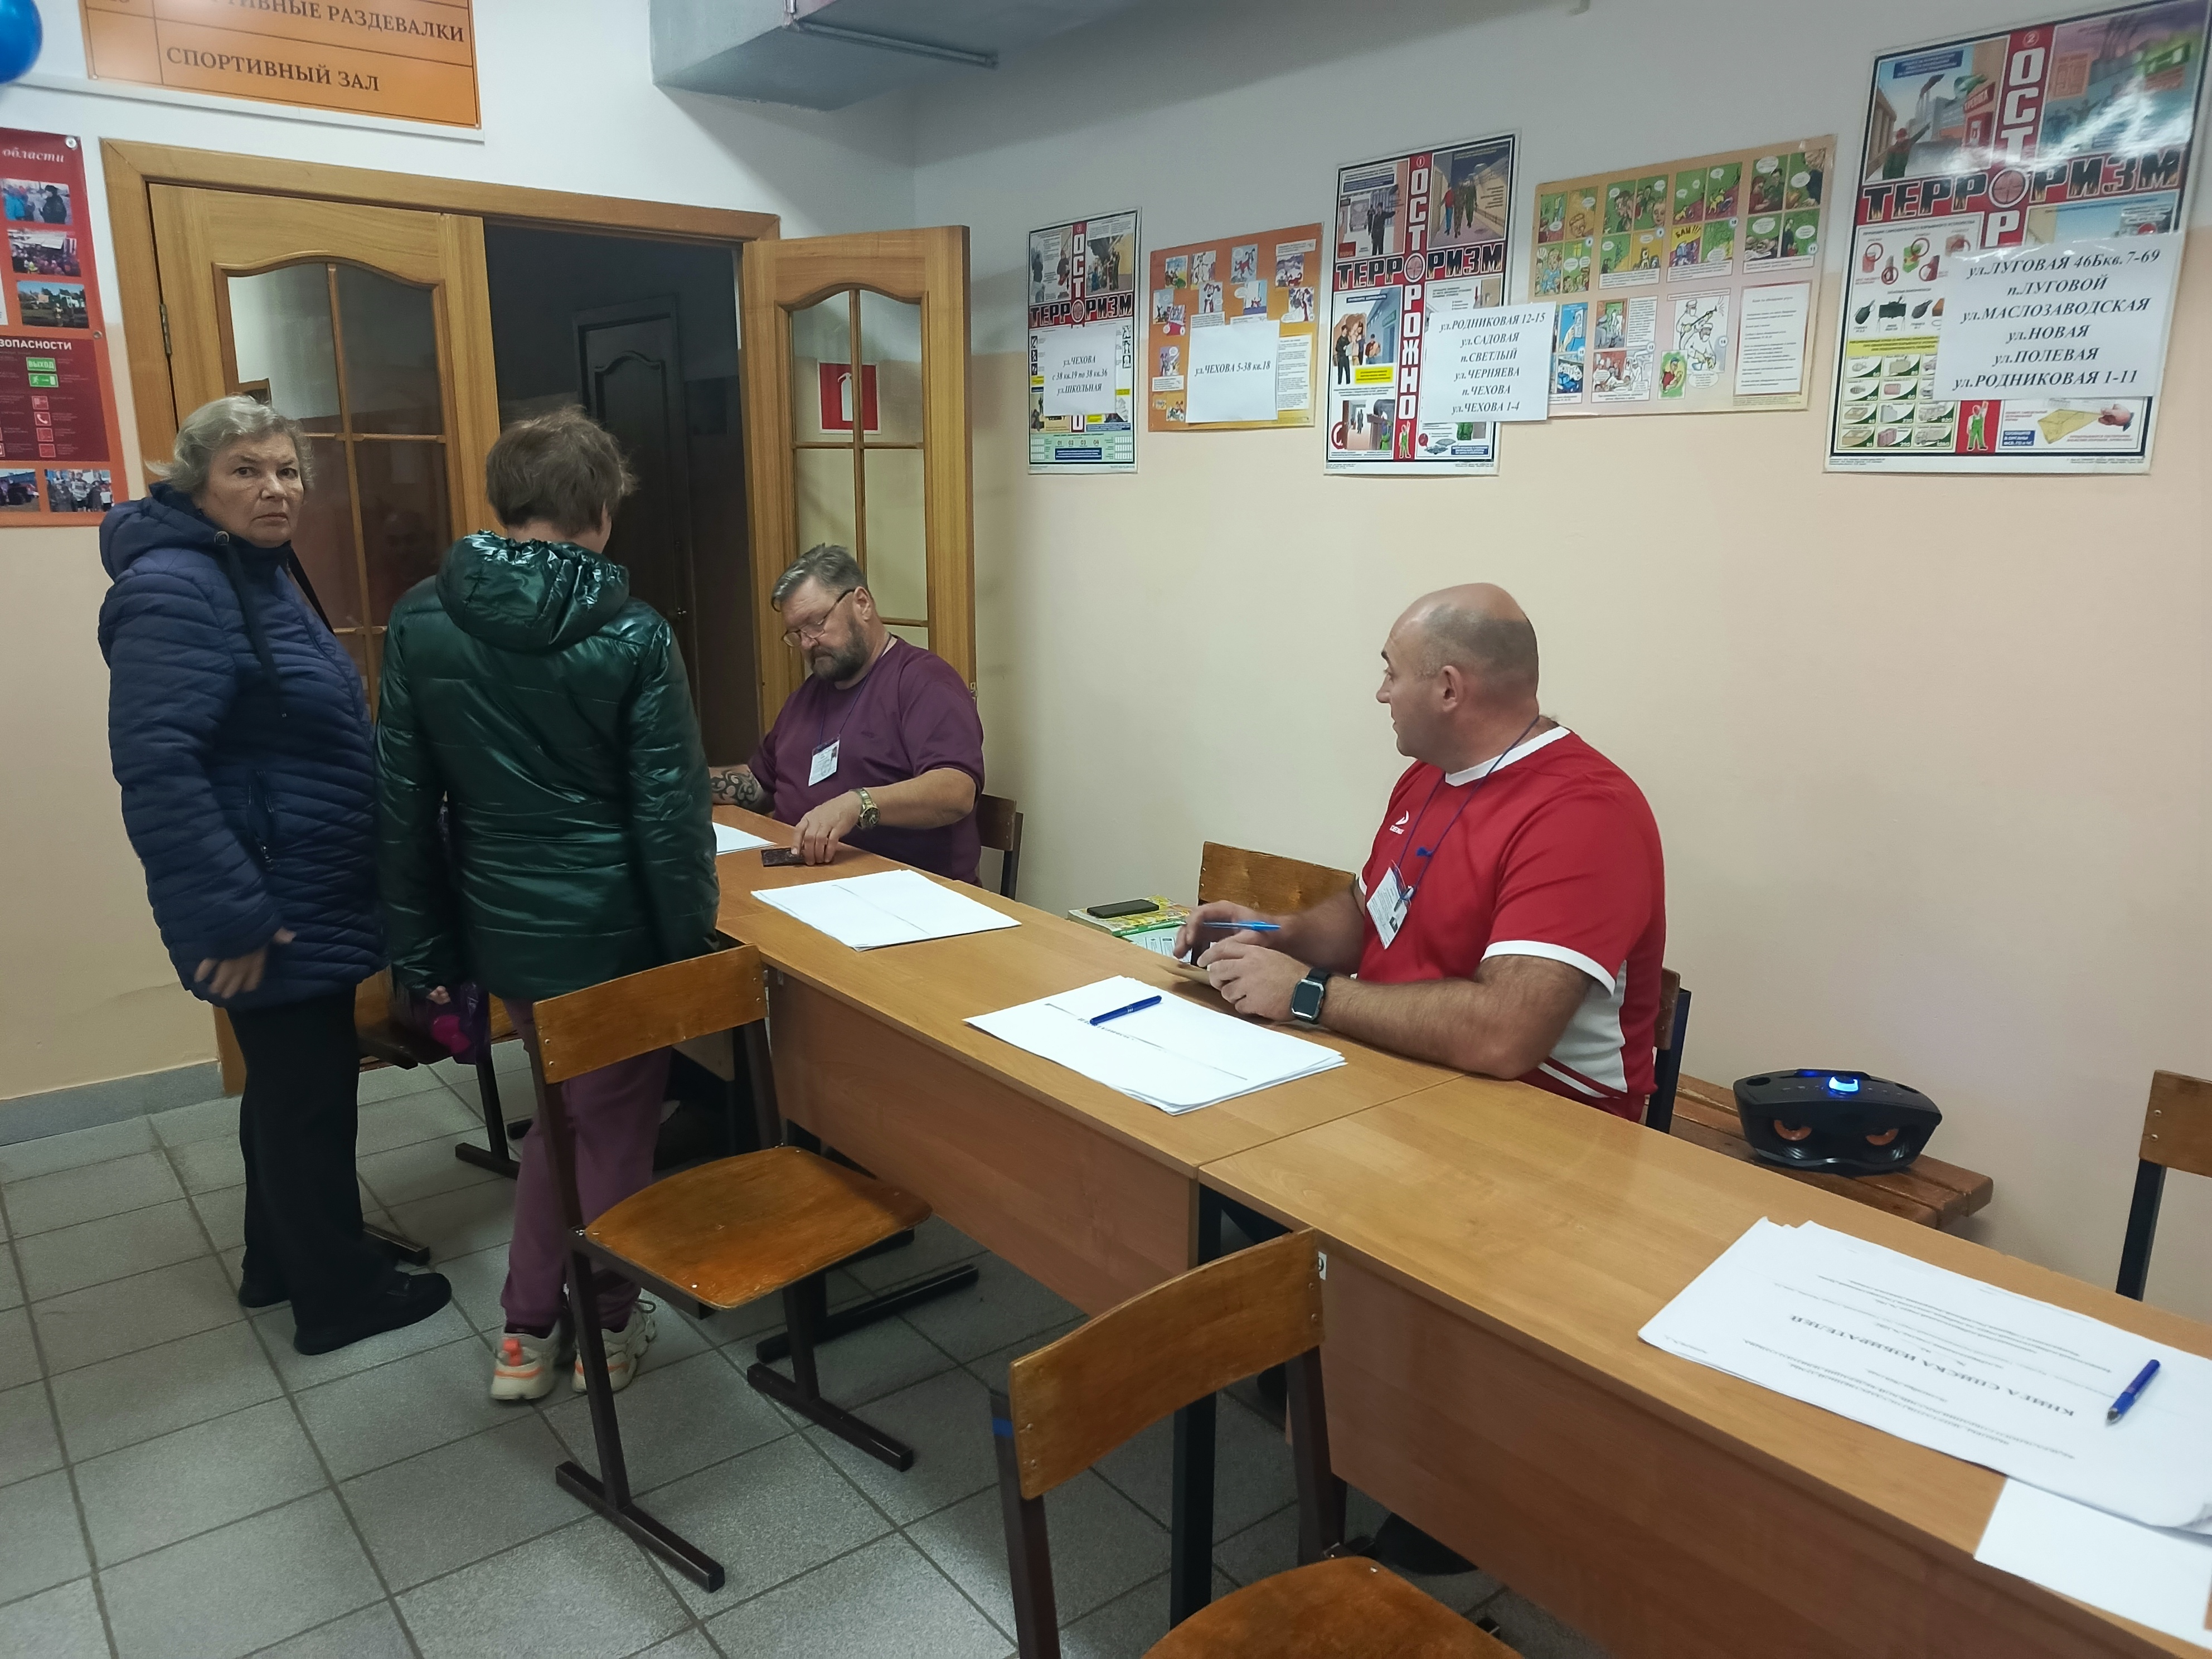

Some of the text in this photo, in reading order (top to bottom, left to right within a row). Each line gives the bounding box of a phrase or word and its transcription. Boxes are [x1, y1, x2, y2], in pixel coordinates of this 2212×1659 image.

[327, 5, 464, 42] РАЗДЕВАЛКИ
[167, 46, 380, 91] СПОРТИВНЫЙ ЗАЛ
[2, 147, 64, 163] области
[1863, 149, 2181, 222] ТЕРРОРИЗМ
[1336, 242, 1504, 290] ТЕРРОРИЗМ
[1966, 256, 2070, 279] ул.ЛУГОВАЯ
[1399, 168, 1429, 419] ОСТОРОЖНО
[2007, 274, 2108, 296] п.ЛУГОВОЙ
[1030, 293, 1133, 327] ТЕРРОРИЗМ
[1959, 298, 2152, 324] ул.МАСЛОЗАВОДСКАЯ
[1439, 312, 1546, 333] ул.РОДНИКОВАЯ 12-15
[1460, 332, 1520, 348] ул.САДОВАЯ
[2005, 324, 2091, 344] ул.НОВАЯ
[1063, 355, 1095, 367] ул.ЧЕХОВА
[1461, 347, 1517, 362] п.СВЕТЛЫЙ
[1992, 348, 2101, 367] ул.ПОЛЕВАЯ
[1056, 372, 1063, 380] 38
[1064, 371, 1078, 380] кв.19
[1086, 370, 1093, 378] 38
[1094, 368, 1108, 377] кв.36
[1195, 360, 1271, 377] ул.ЧЕХОВА 5-38 кв.18
[1454, 367, 1520, 382] ул.ЧЕРНЯЕВА
[1057, 383, 1102, 396] ул.ШКОЛЬНАЯ
[1462, 385, 1511, 396] п.ЧЕХОВА
[1952, 370, 2138, 391] ул.РОДНИКОВАЯ 1-11
[1452, 401, 1520, 415] ул.ЧЕХОВА 1-4
